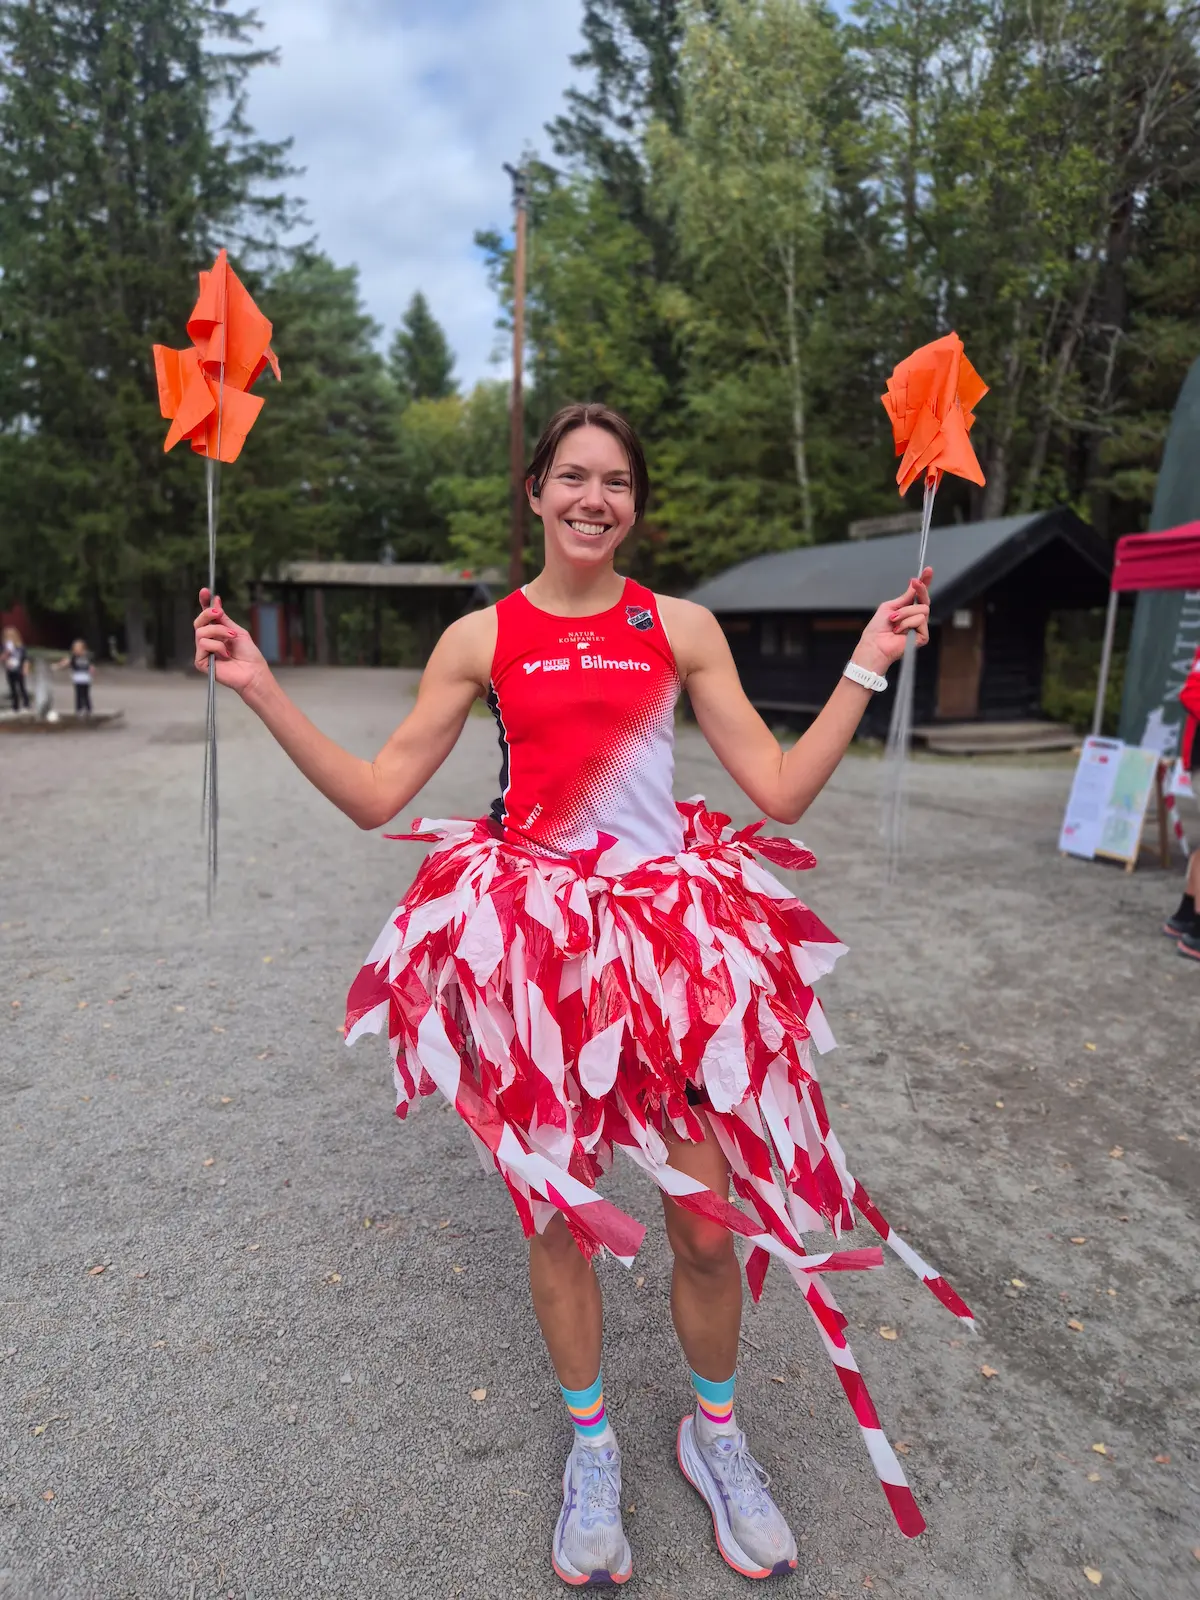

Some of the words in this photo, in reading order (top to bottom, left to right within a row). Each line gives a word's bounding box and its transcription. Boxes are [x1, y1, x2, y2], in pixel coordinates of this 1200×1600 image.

[542, 657, 570, 666] INTER
[580, 655, 651, 672] Bilmetro
[543, 664, 570, 672] SPORT
